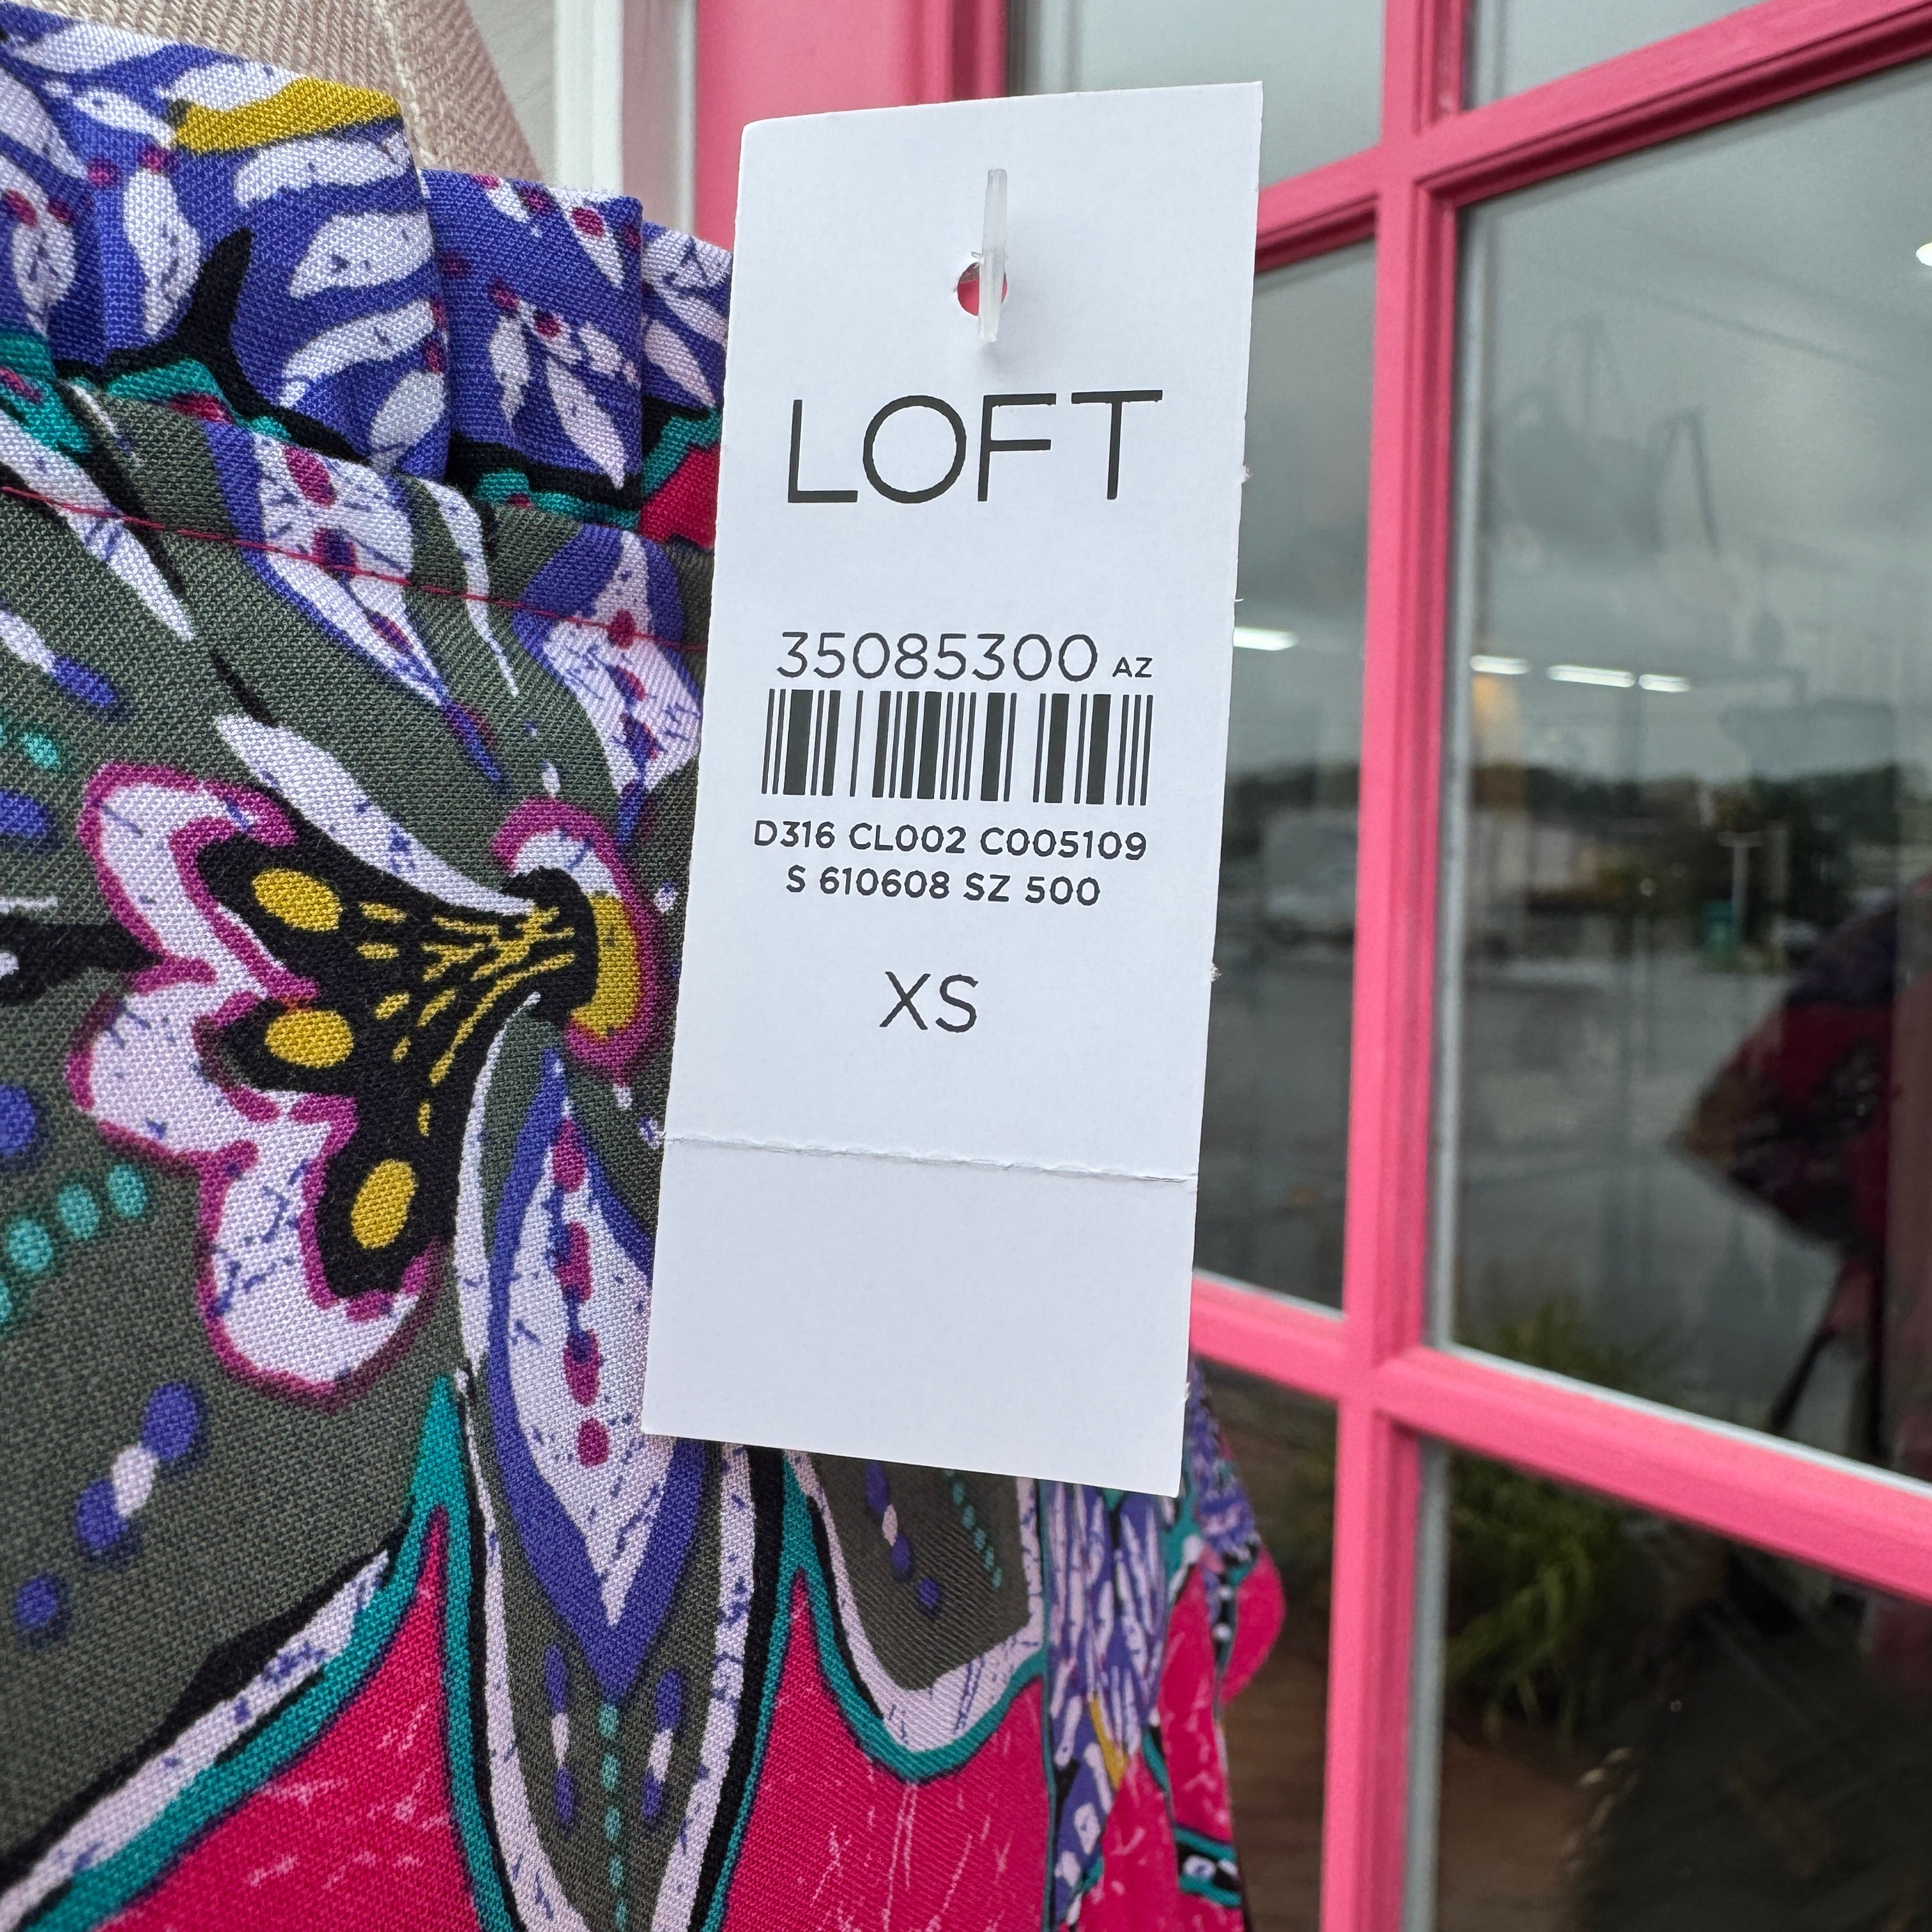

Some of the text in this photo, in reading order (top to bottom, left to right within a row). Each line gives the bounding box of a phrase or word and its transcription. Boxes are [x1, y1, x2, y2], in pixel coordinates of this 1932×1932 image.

[787, 389, 1163, 504] LOFT
[776, 631, 1153, 682] 35085300 AZ
[754, 820, 1147, 861] D316 CL002 C005109
[786, 864, 1101, 906] S 610608 SZ 500
[879, 971, 979, 1034] XS
